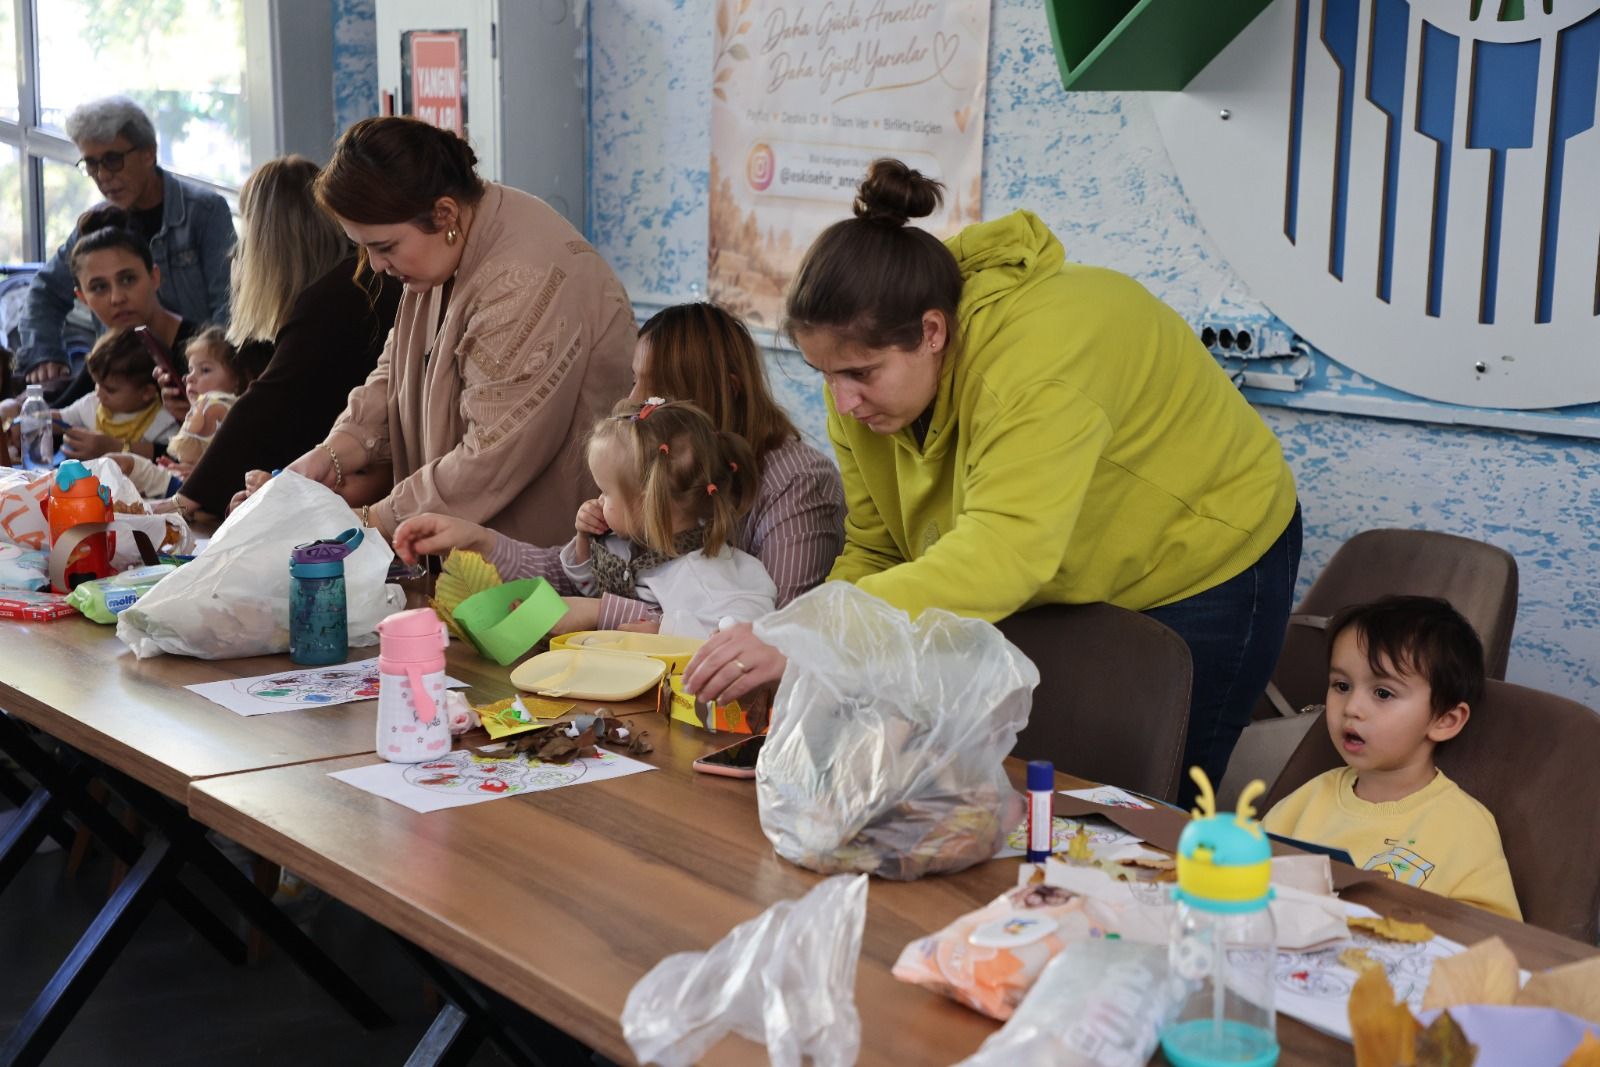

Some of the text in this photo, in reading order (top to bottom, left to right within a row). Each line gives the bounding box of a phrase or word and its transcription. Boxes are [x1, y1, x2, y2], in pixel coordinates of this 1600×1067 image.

[760, 7, 809, 54] Daha
[864, 0, 937, 33] Anneler
[417, 67, 456, 98] YANGIN
[767, 51, 814, 94] Daha
[781, 167, 861, 190] @eskisehir_anne
